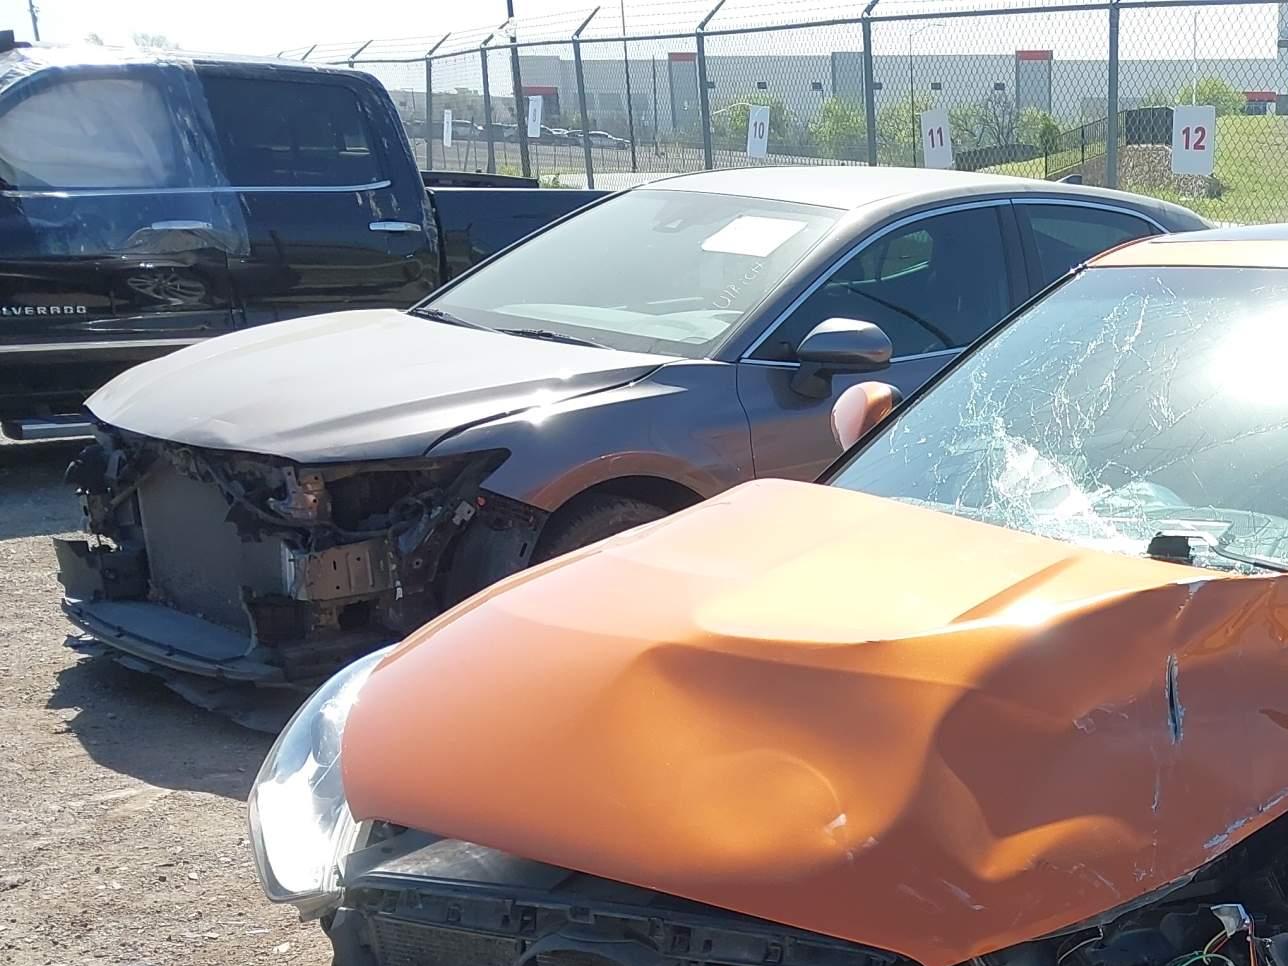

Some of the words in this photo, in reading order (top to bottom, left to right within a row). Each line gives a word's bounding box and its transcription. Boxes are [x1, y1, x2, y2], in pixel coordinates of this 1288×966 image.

[754, 121, 765, 139] 10
[928, 127, 943, 148] 11
[1182, 126, 1206, 150] 12
